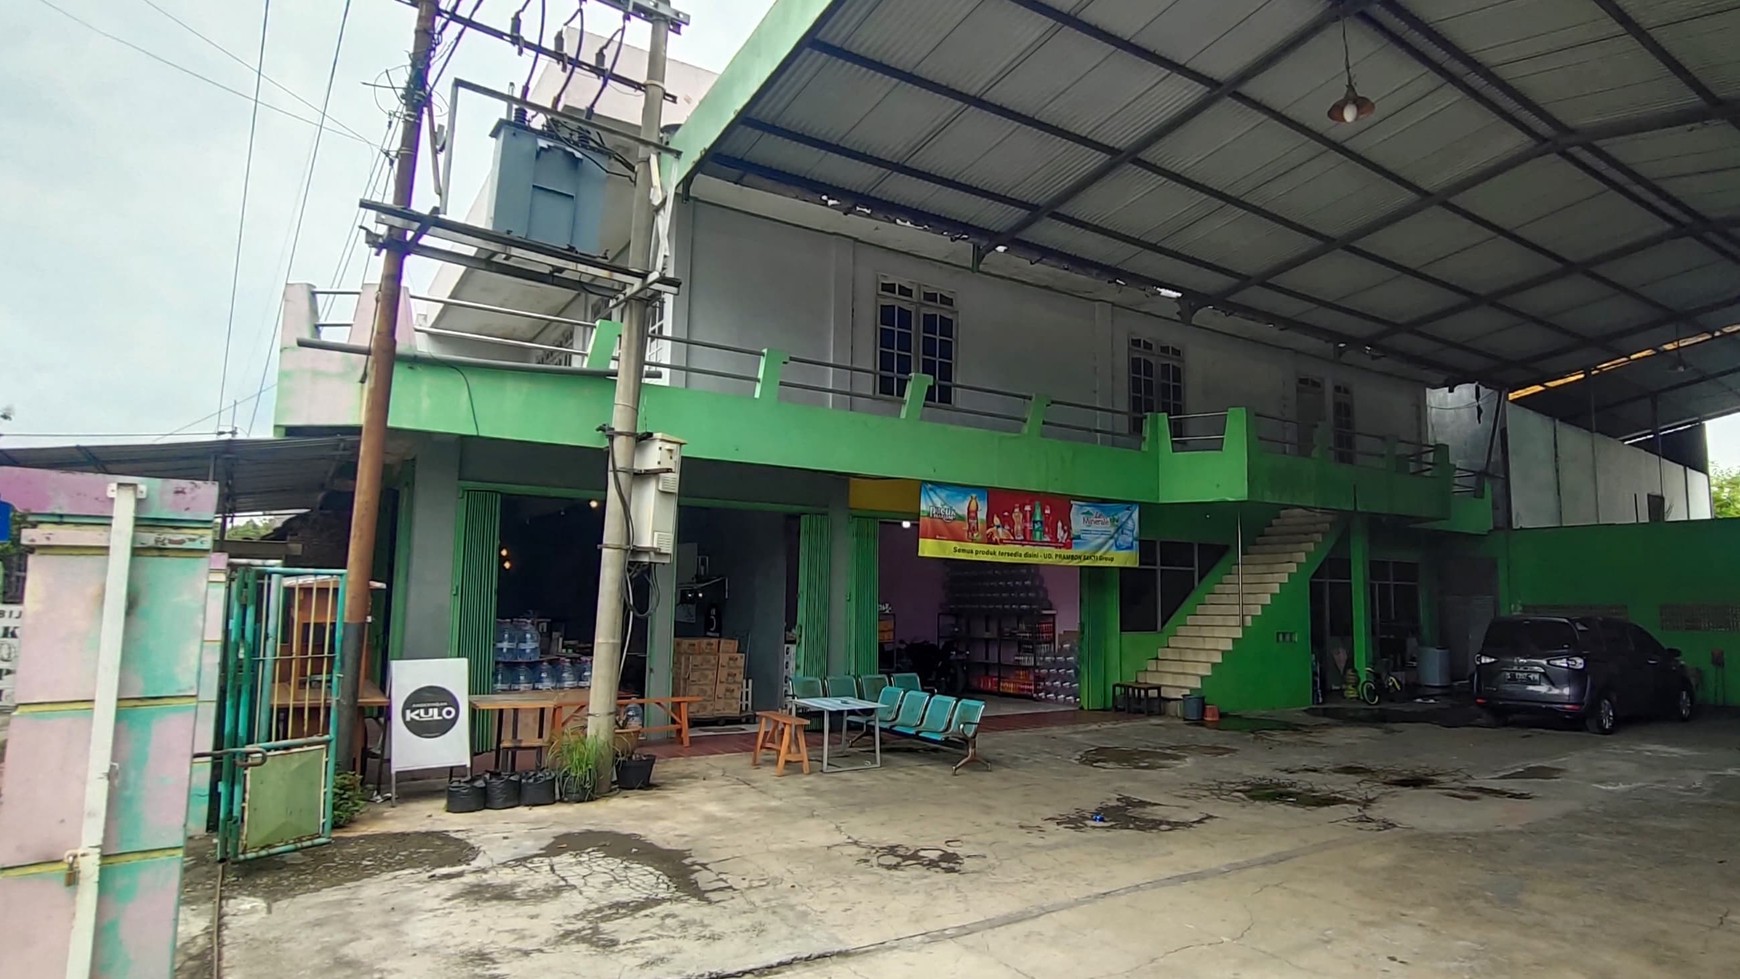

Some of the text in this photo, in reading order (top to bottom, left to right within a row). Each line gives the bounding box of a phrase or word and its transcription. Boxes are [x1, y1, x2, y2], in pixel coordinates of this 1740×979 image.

[953, 546, 974, 554] Semua
[975, 548, 997, 556] produk
[998, 550, 1023, 558] tersedia
[1023, 551, 1039, 559] disini
[405, 706, 456, 722] KULO
